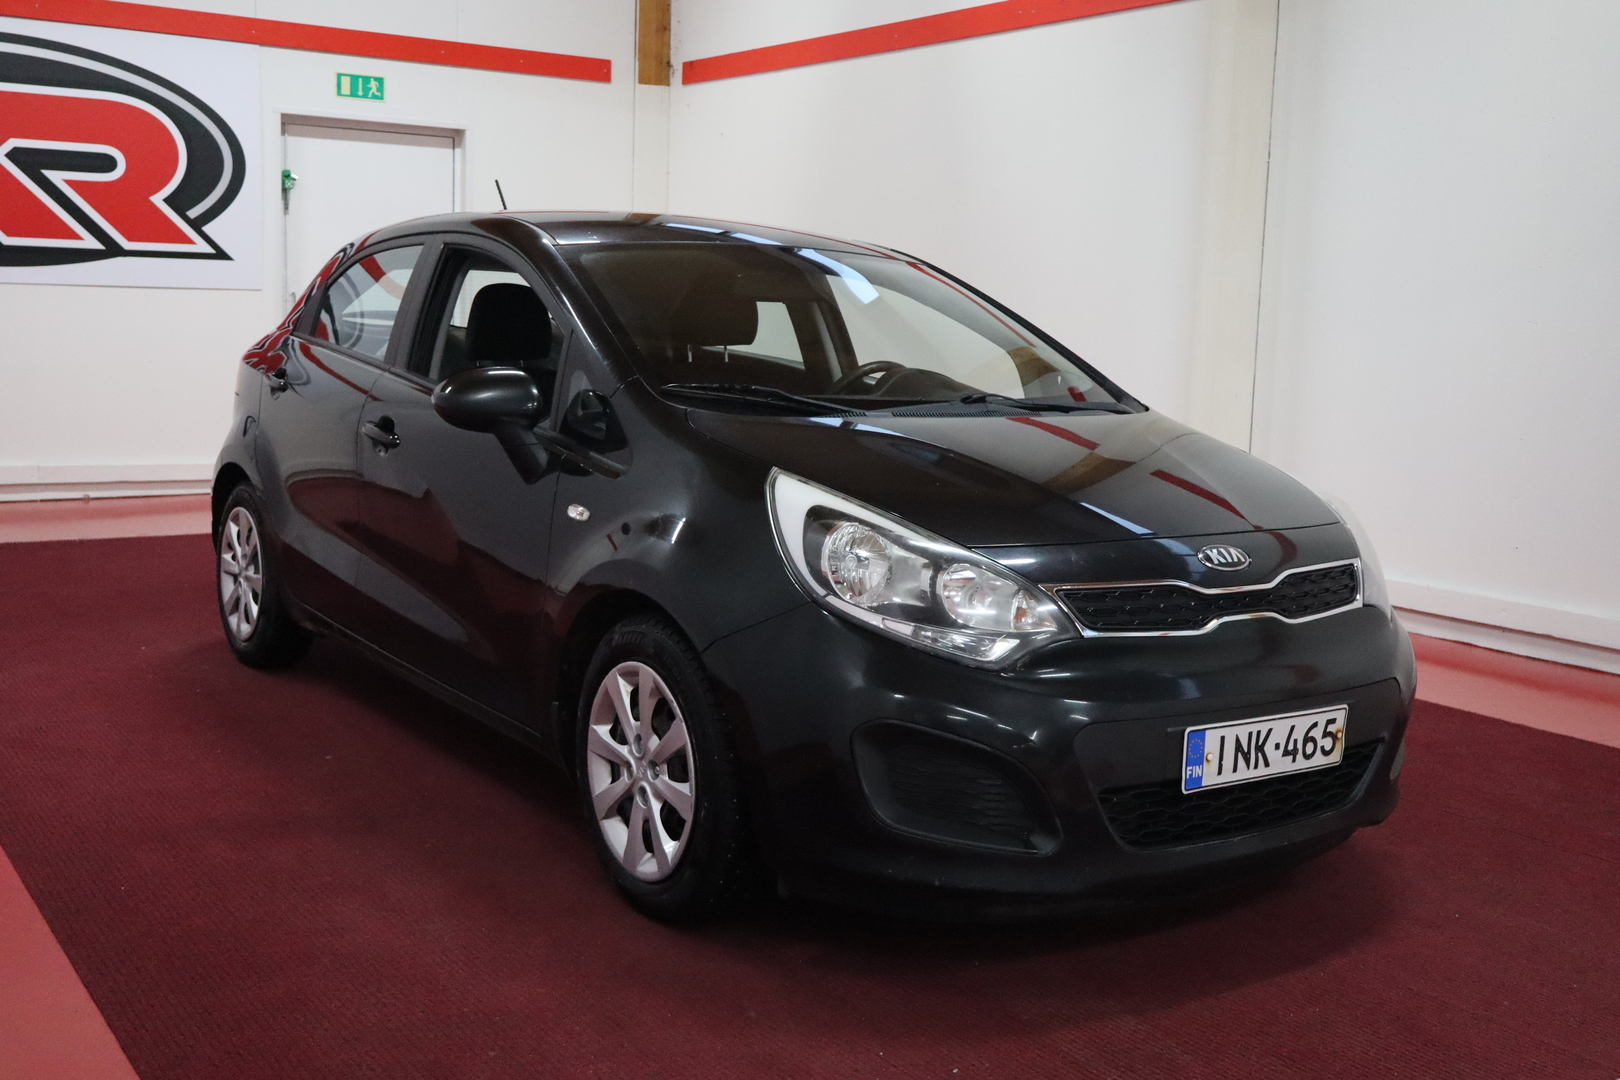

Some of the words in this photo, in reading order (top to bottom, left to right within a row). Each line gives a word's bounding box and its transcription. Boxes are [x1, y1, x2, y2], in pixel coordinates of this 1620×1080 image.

[1204, 547, 1246, 565] KIA
[1217, 717, 1338, 777] INK-465
[1186, 765, 1203, 779] FIN
